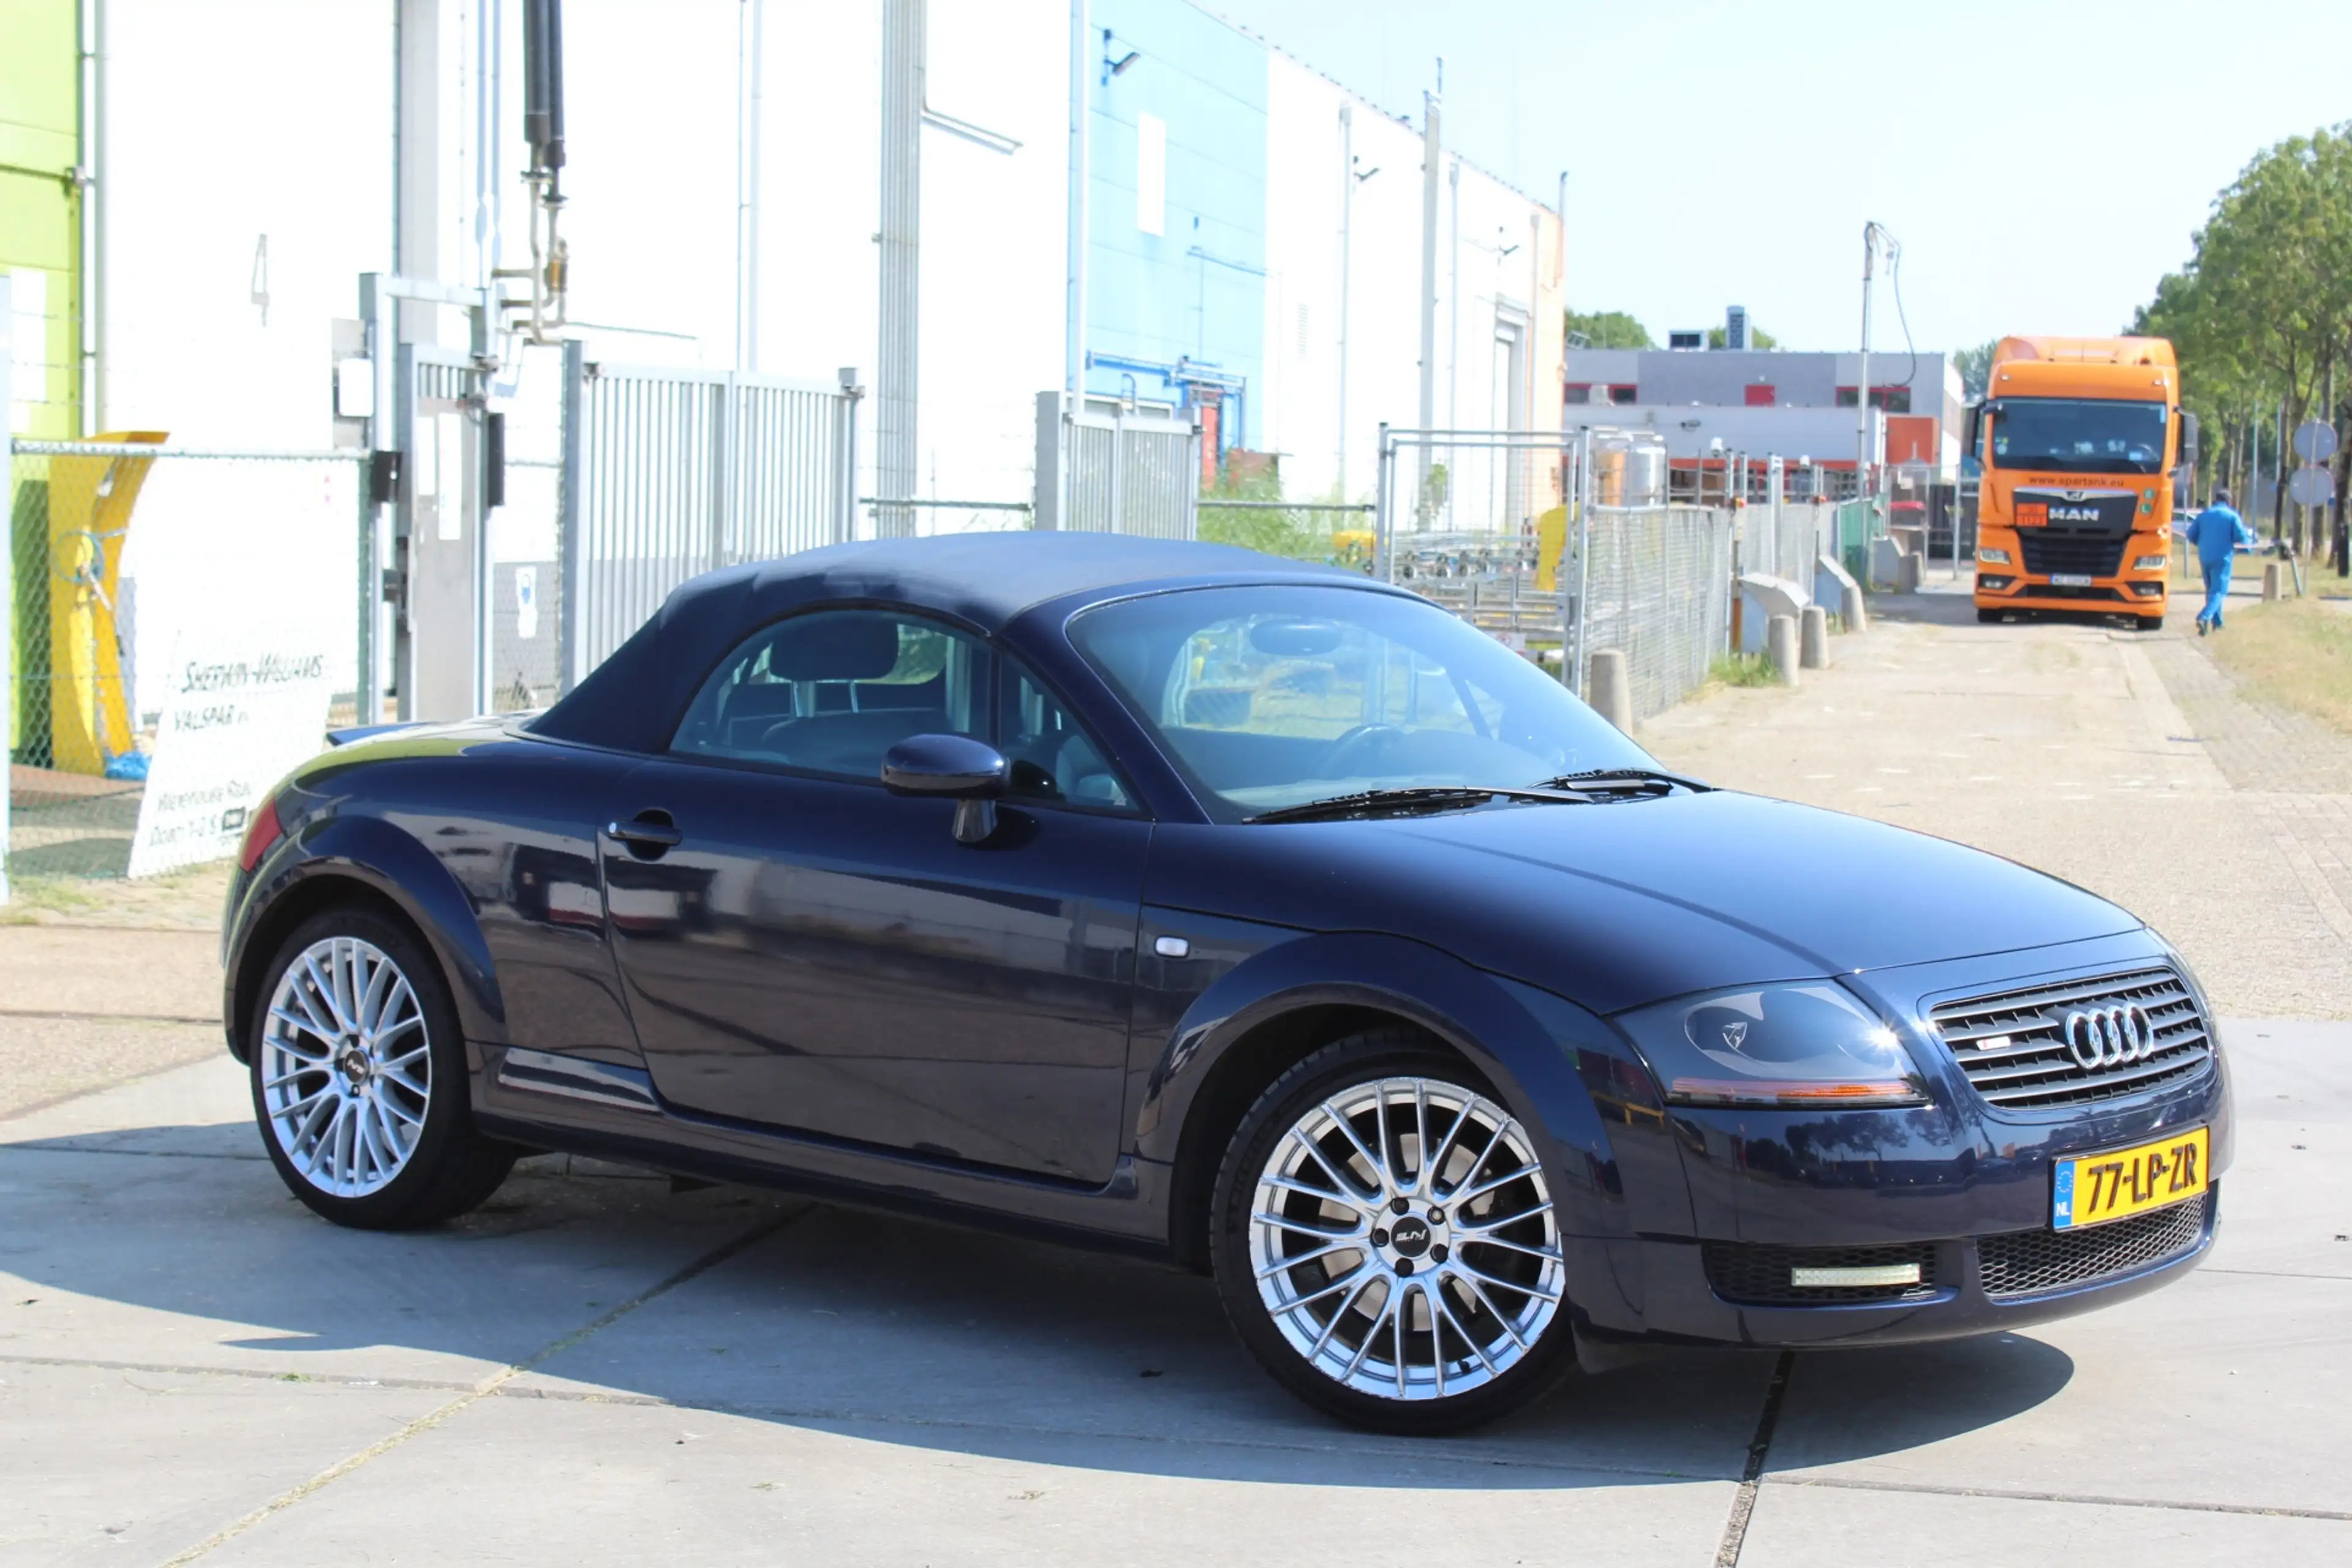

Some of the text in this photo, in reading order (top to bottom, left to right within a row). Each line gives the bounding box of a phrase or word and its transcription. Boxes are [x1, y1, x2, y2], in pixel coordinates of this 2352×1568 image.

[2029, 475, 2124, 486] www.spartank.eu
[2049, 507, 2100, 521] MAN
[2087, 1142, 2198, 1215] 77-LP-ZR
[2056, 1201, 2070, 1216] NL
